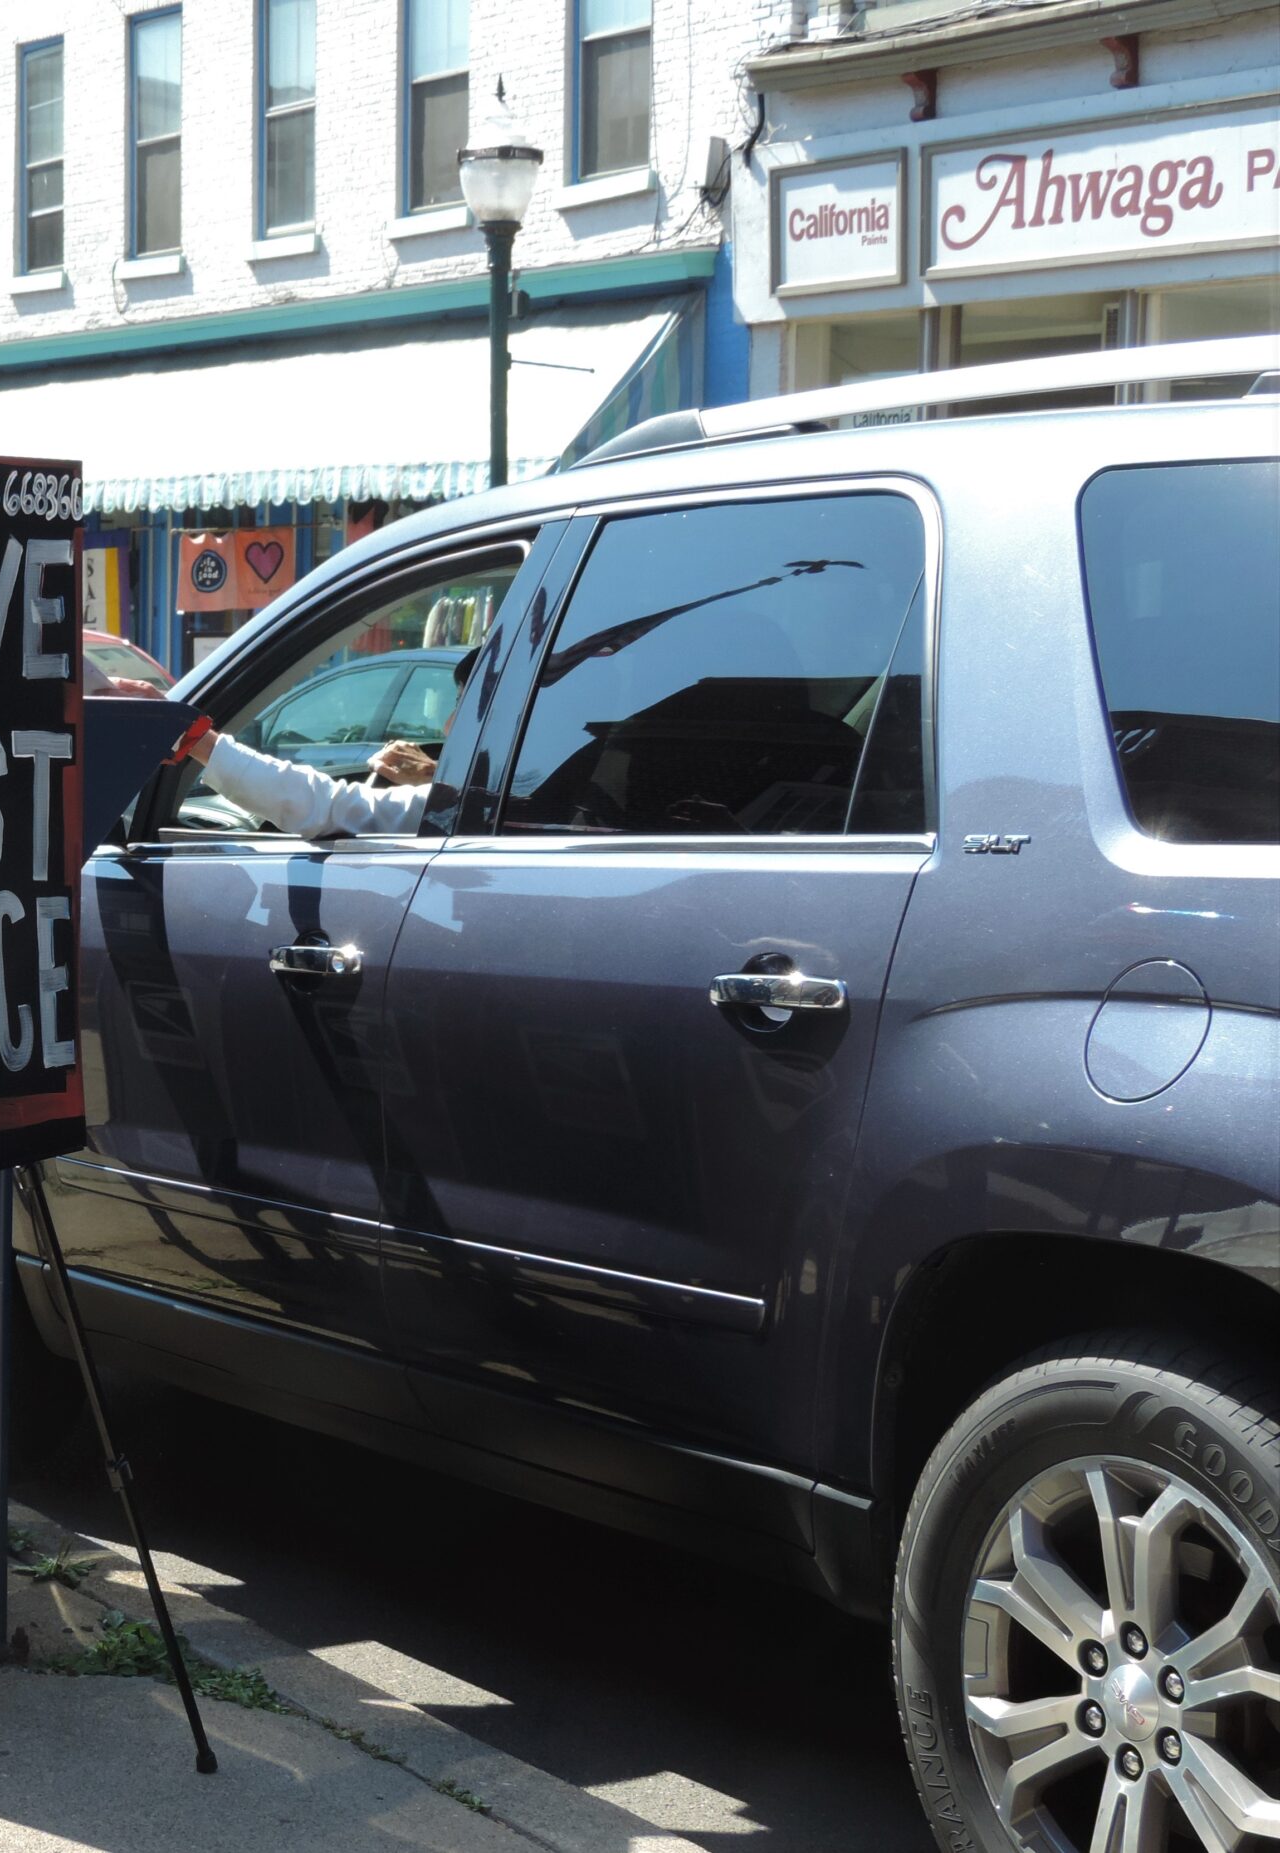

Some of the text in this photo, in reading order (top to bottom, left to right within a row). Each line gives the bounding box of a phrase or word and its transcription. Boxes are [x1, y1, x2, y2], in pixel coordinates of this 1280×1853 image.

[788, 197, 890, 242] California
[940, 148, 1224, 251] Ahwaga
[861, 235, 888, 247] Paints
[83, 557, 97, 631] SAL
[962, 834, 1031, 855] SLT
